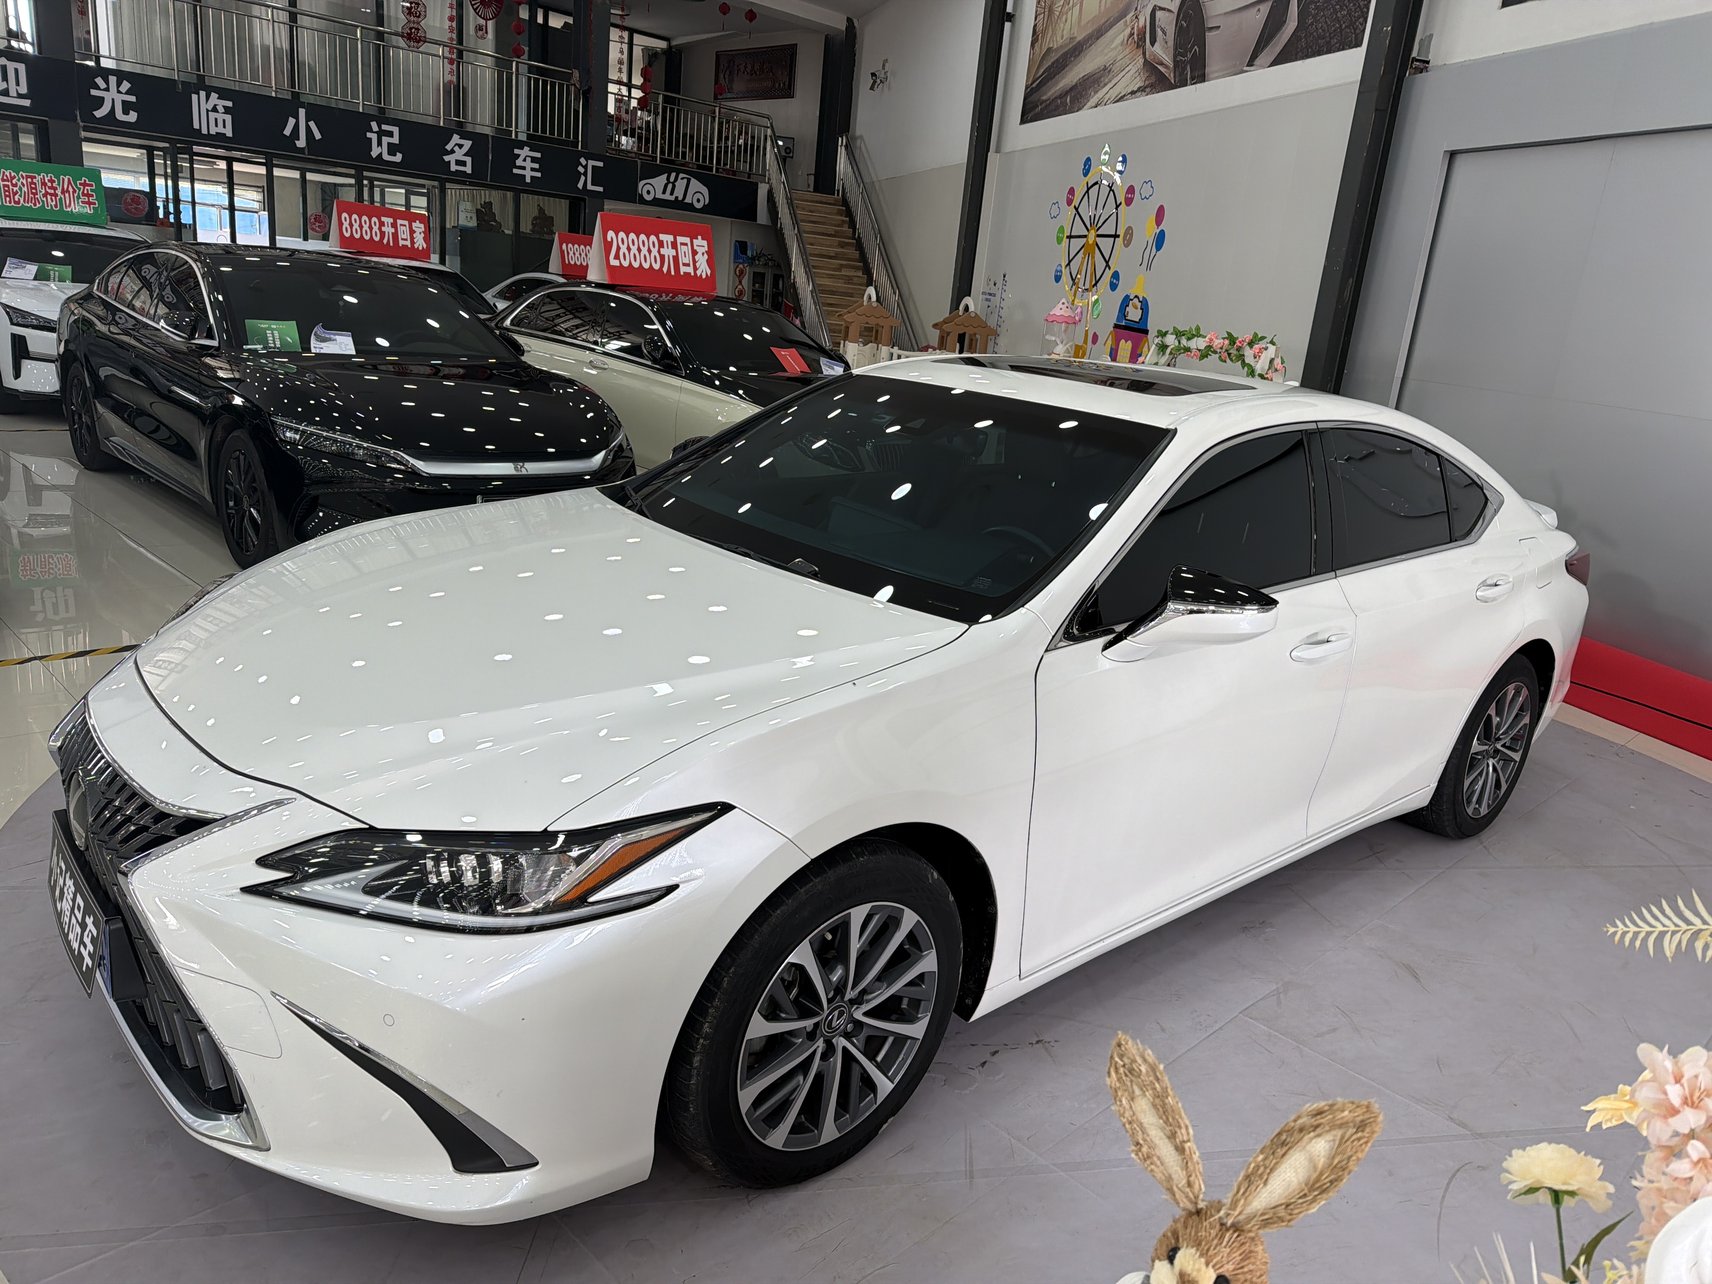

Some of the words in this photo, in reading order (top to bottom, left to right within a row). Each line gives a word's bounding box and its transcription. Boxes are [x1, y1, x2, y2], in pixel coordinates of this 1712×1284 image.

[341, 212, 427, 250] 8888开回家
[561, 242, 593, 267] 18888
[606, 230, 712, 280] 28888开回家
